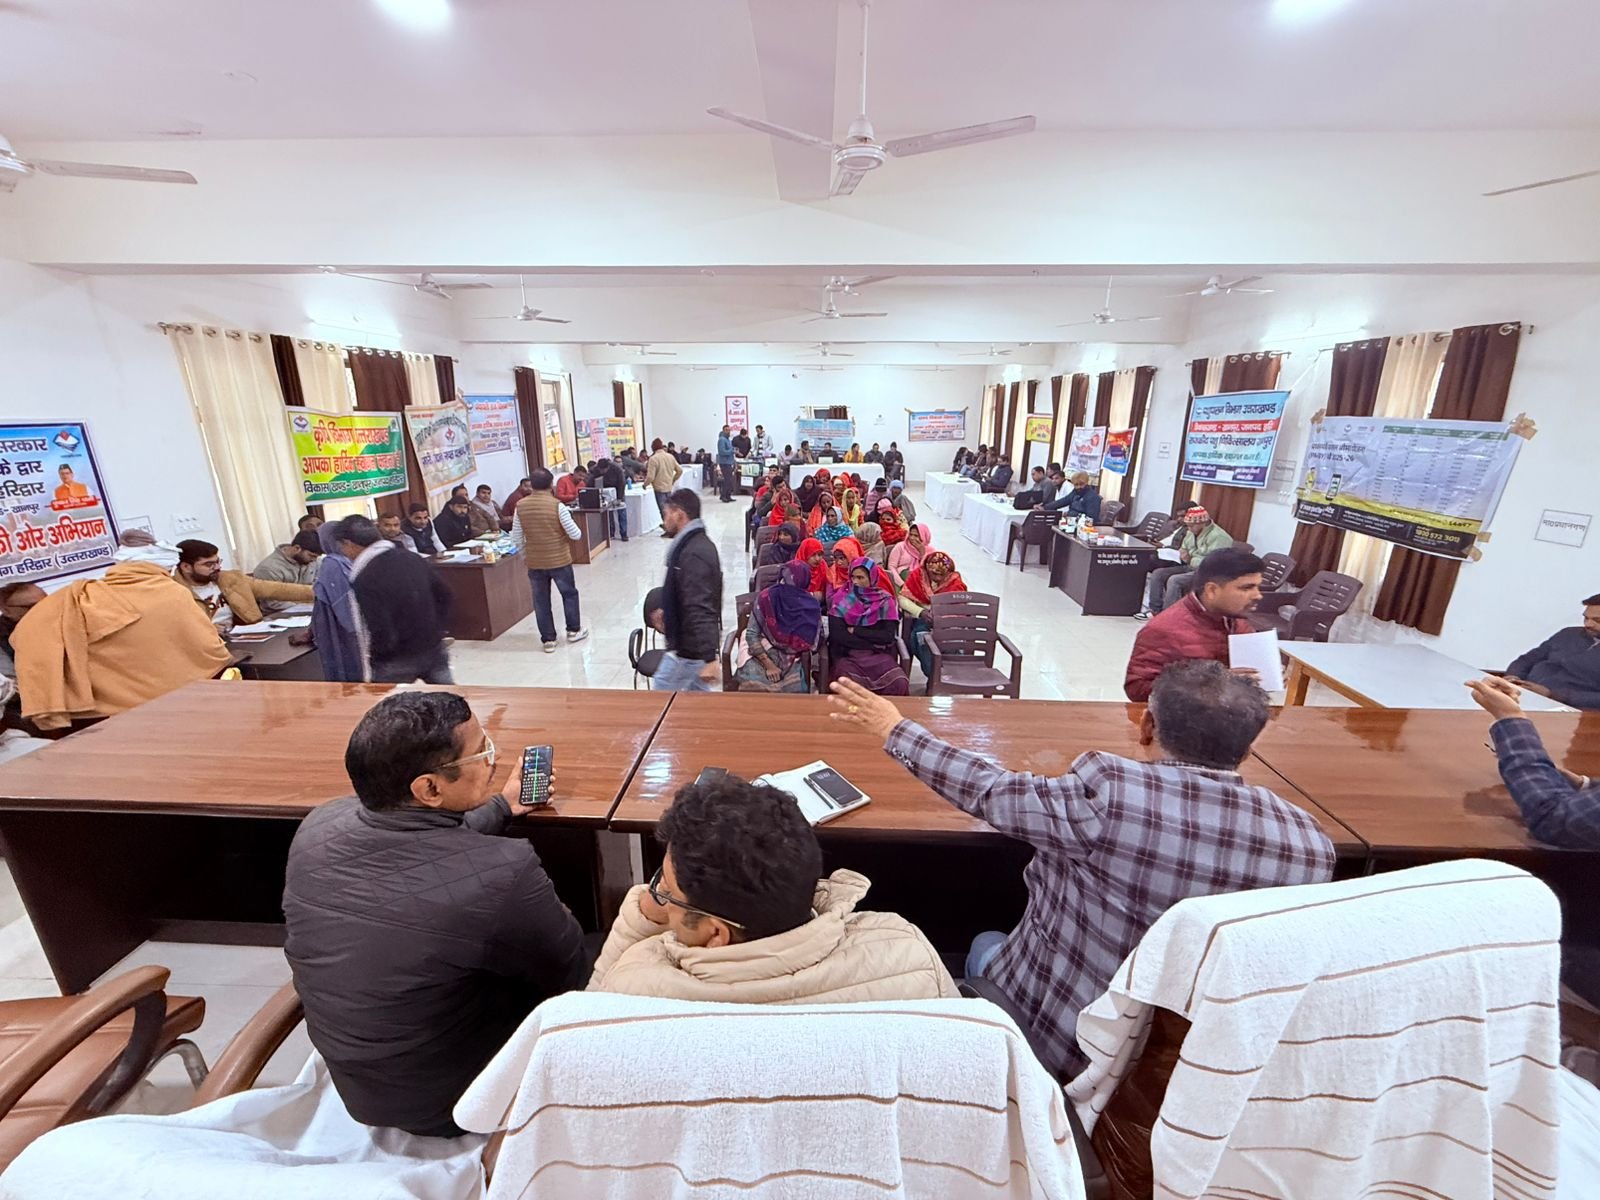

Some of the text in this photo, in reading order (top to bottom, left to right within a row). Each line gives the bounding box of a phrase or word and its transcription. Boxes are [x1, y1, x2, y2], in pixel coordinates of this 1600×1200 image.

[15, 460, 44, 476] द्वार
[302, 456, 332, 474] आपका
[304, 480, 329, 494] विकास
[11, 503, 40, 514] खानपुर
[16, 522, 47, 551] ओर
[48, 515, 107, 545] अभियान
[16, 557, 52, 574] हरिद्वार
[55, 543, 114, 568] (उत्तराखण्ड)
